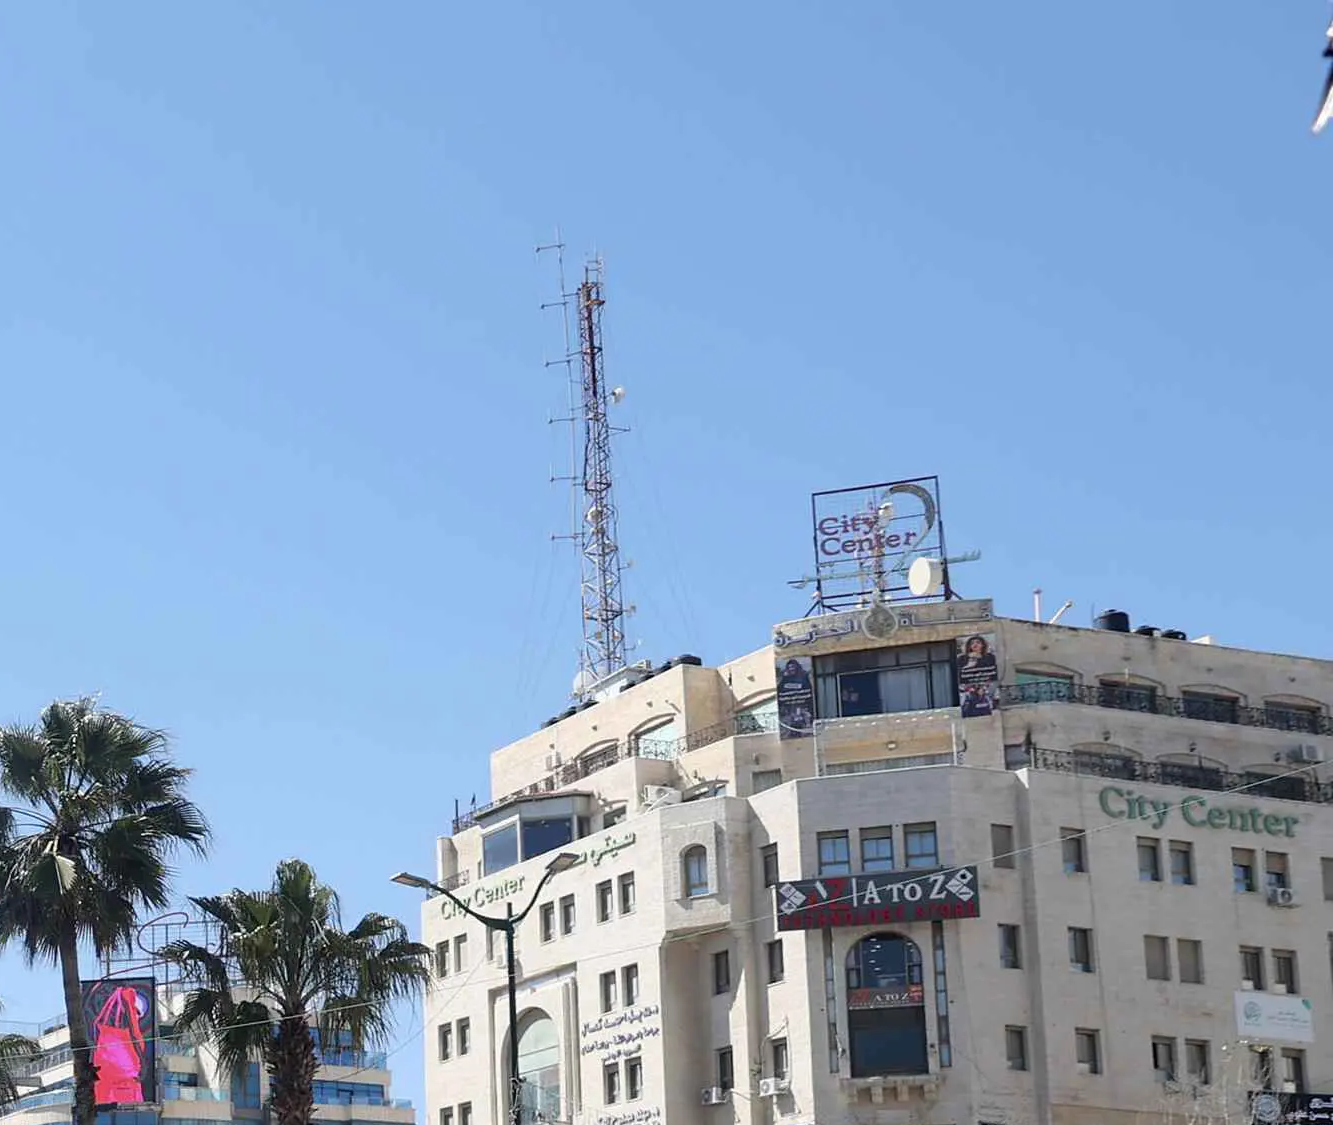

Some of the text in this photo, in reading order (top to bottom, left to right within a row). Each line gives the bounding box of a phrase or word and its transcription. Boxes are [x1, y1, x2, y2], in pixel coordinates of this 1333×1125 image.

[818, 513, 880, 537] City
[820, 530, 917, 558] Center
[1098, 785, 1300, 838] City Center
[441, 874, 526, 921] City Center
[863, 874, 947, 905] A TO Z
